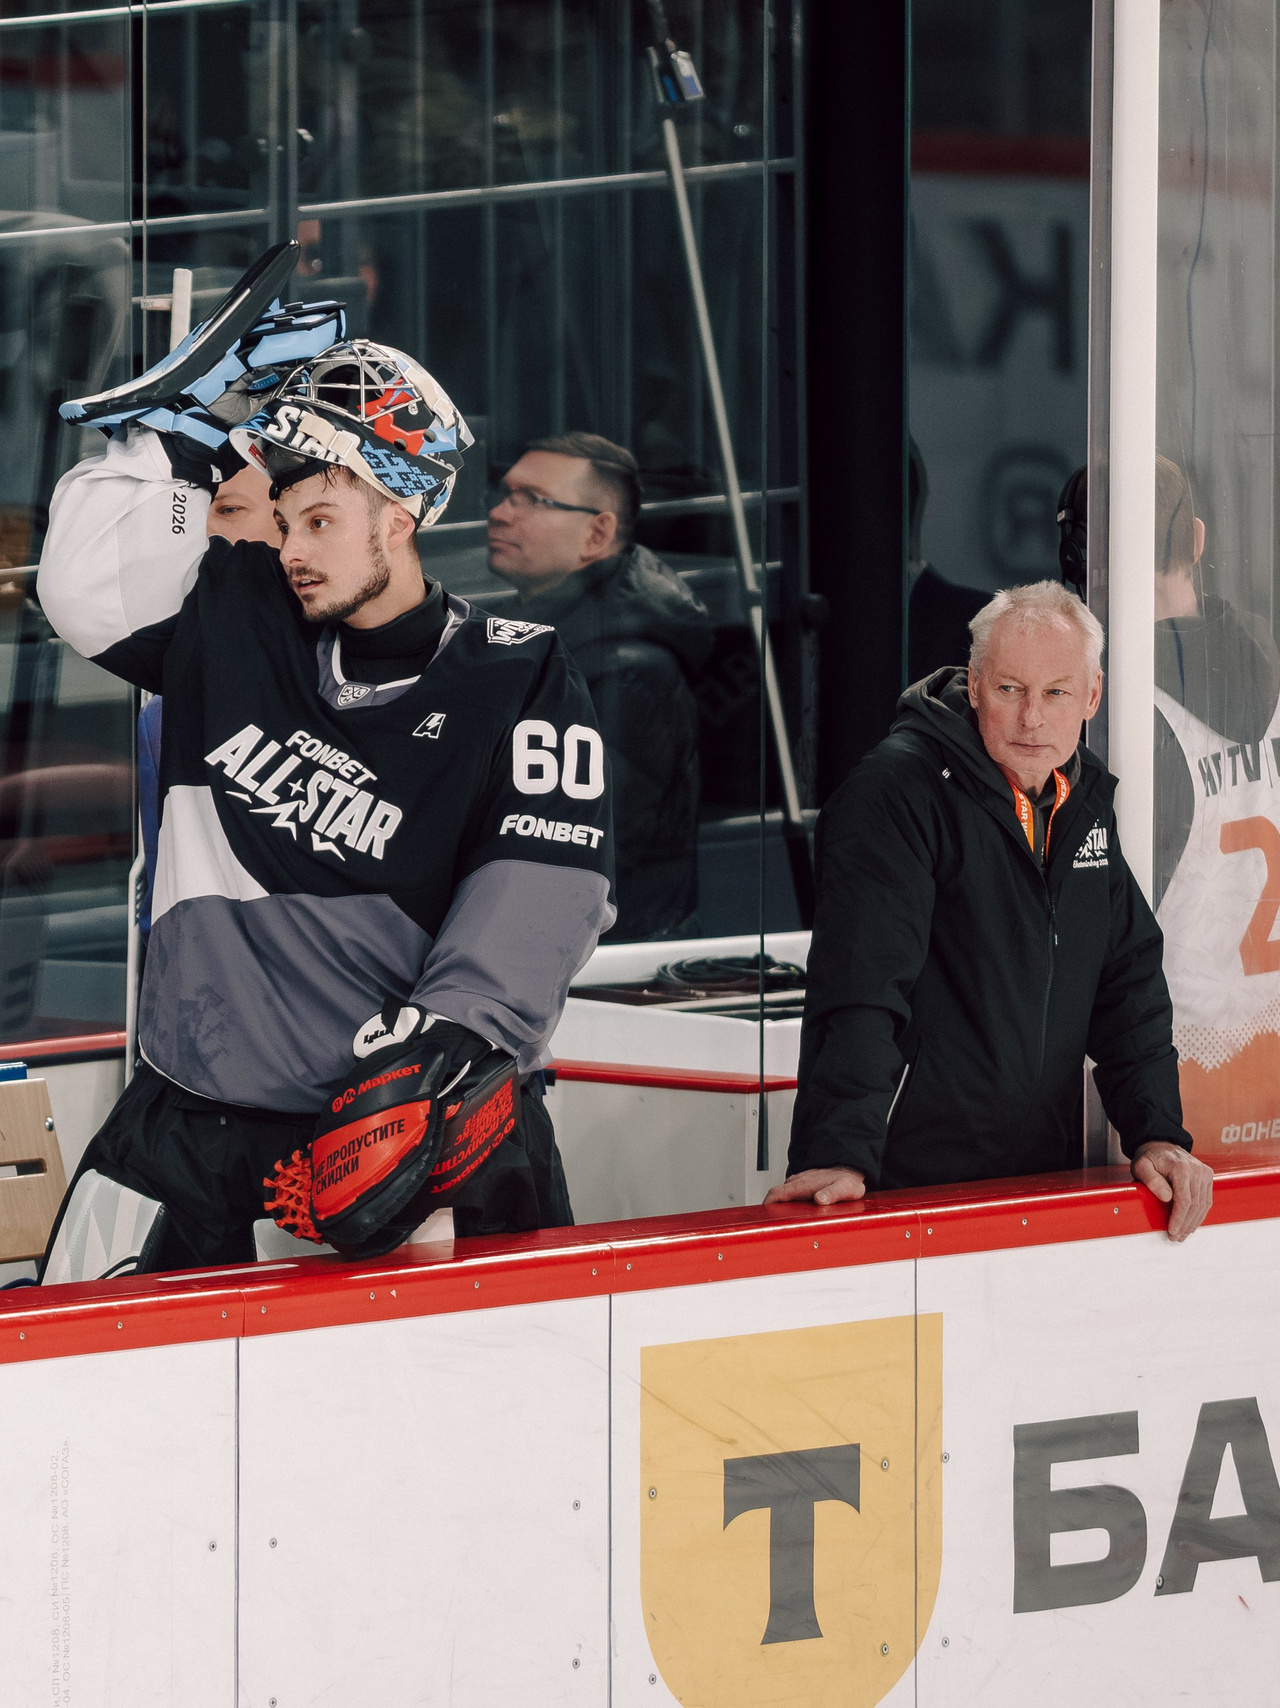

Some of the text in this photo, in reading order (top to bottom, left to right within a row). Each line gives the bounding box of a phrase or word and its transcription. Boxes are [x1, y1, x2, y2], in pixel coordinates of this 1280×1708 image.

[172, 491, 187, 534] 2026
[285, 730, 378, 786] FONBET
[512, 719, 605, 800] 60
[204, 723, 403, 860] ALL STAR
[499, 813, 605, 849] FONBET
[357, 1064, 421, 1096] Маркет
[326, 1118, 406, 1172] ПРОПУСТИТЕ
[315, 1155, 360, 1195] СКИДКИ
